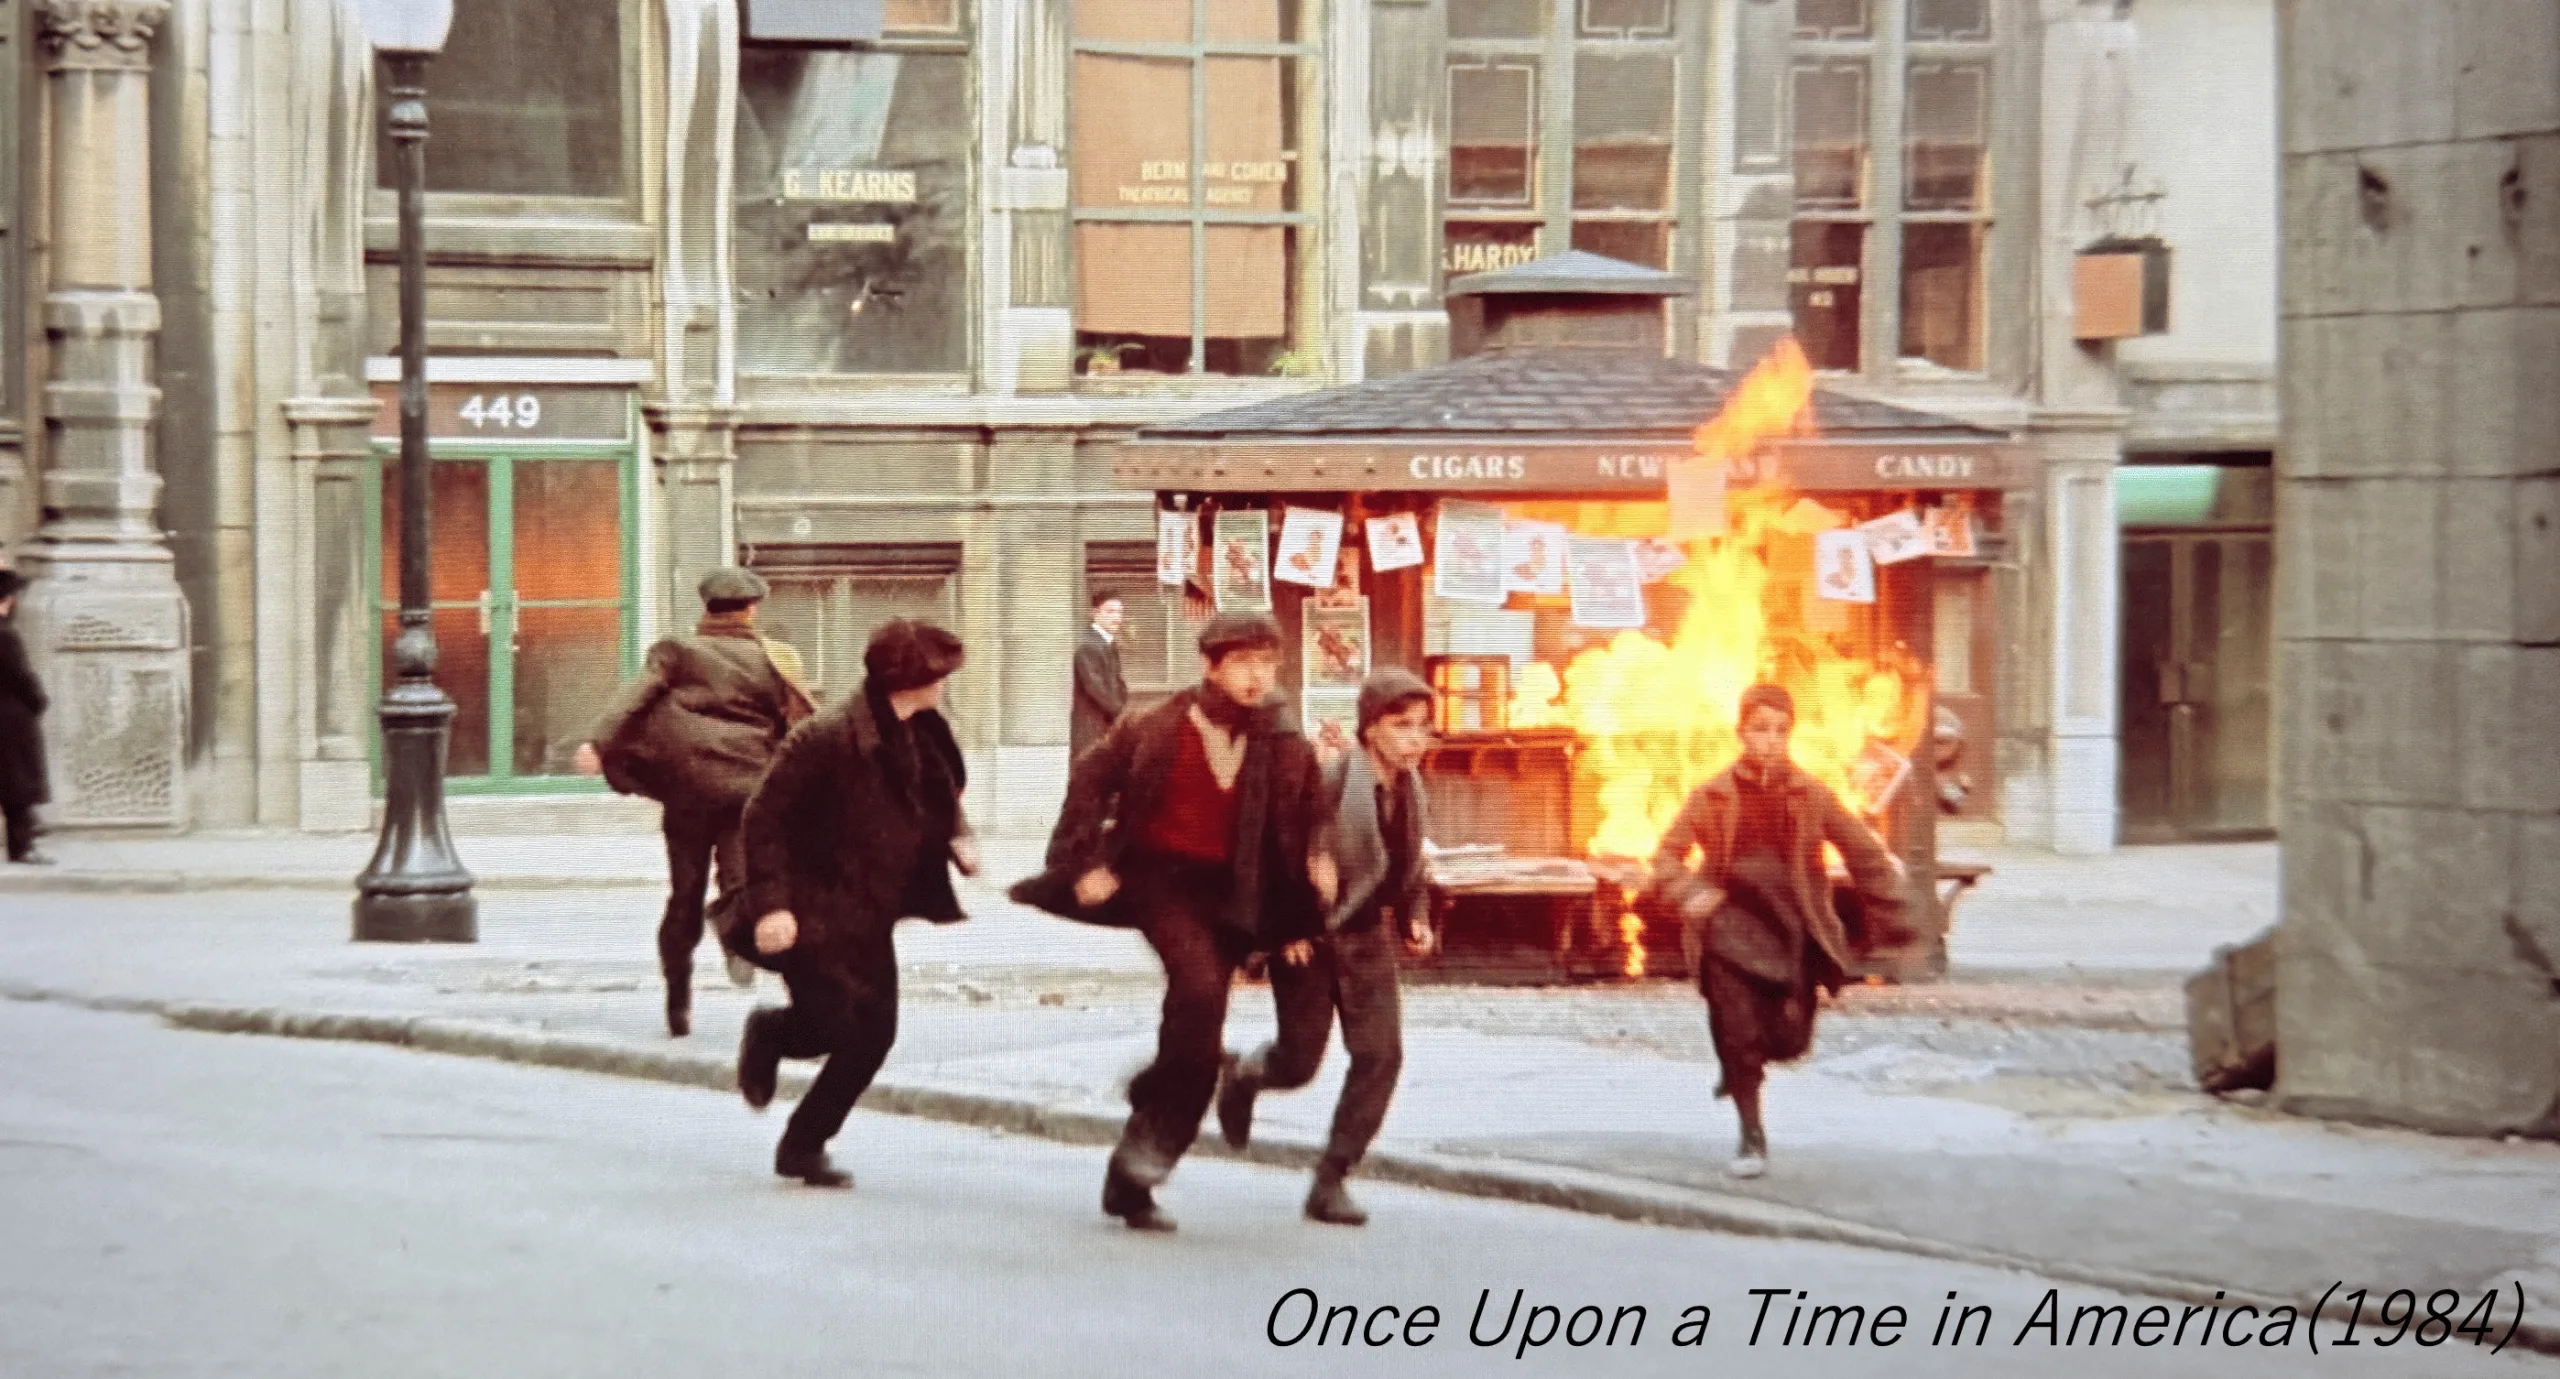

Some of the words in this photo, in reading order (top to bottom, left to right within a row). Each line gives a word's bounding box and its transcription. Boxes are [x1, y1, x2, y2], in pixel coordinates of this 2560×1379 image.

[819, 170, 917, 200] KEARNS
[459, 393, 541, 429] 449
[1408, 454, 1526, 479] CIGARS
[1875, 454, 1974, 478] CANDY
